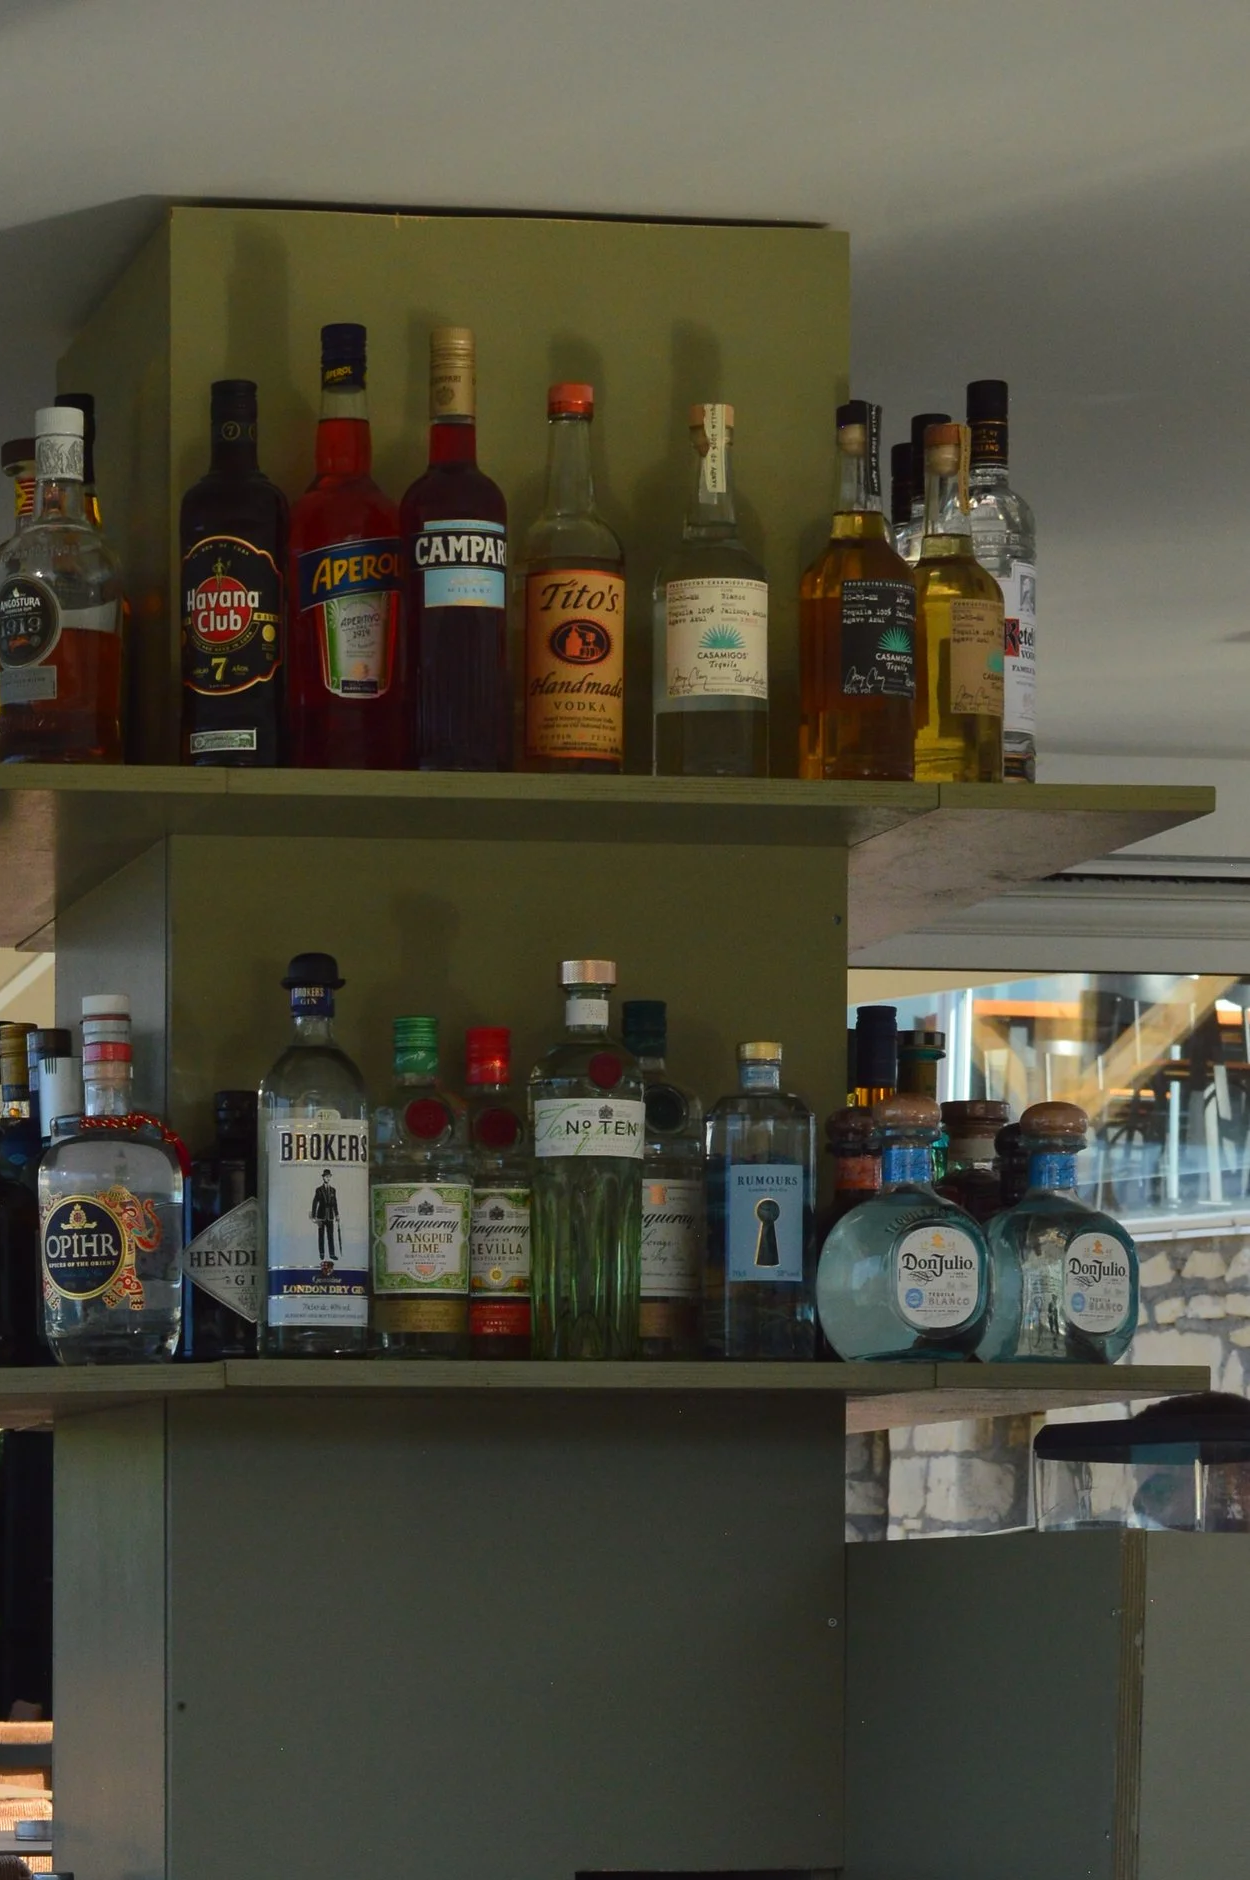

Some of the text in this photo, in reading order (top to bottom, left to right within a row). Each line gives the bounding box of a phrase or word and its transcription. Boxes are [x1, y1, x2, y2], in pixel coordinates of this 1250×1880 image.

[414, 535, 508, 567] CAMPARI
[186, 587, 260, 613] Havana
[539, 579, 620, 613] Tito's
[197, 609, 243, 633] Club
[696, 651, 747, 660] CASAMIGOS
[211, 657, 227, 681] 7
[529, 671, 623, 699] Handmade
[553, 701, 606, 713] VODKA
[299, 998, 317, 1006] GIN
[598, 1120, 638, 1137] TEN
[737, 1175, 798, 1186] RUMOURS
[389, 1214, 460, 1233] Tanqueray
[396, 1232, 453, 1244] RANGPUR
[411, 1243, 440, 1254] LIME
[76, 1260, 89, 1268] THE
[282, 1284, 328, 1294] LONDON
[328, 1285, 350, 1294] DRY
[927, 1297, 970, 1306] BLANCO
